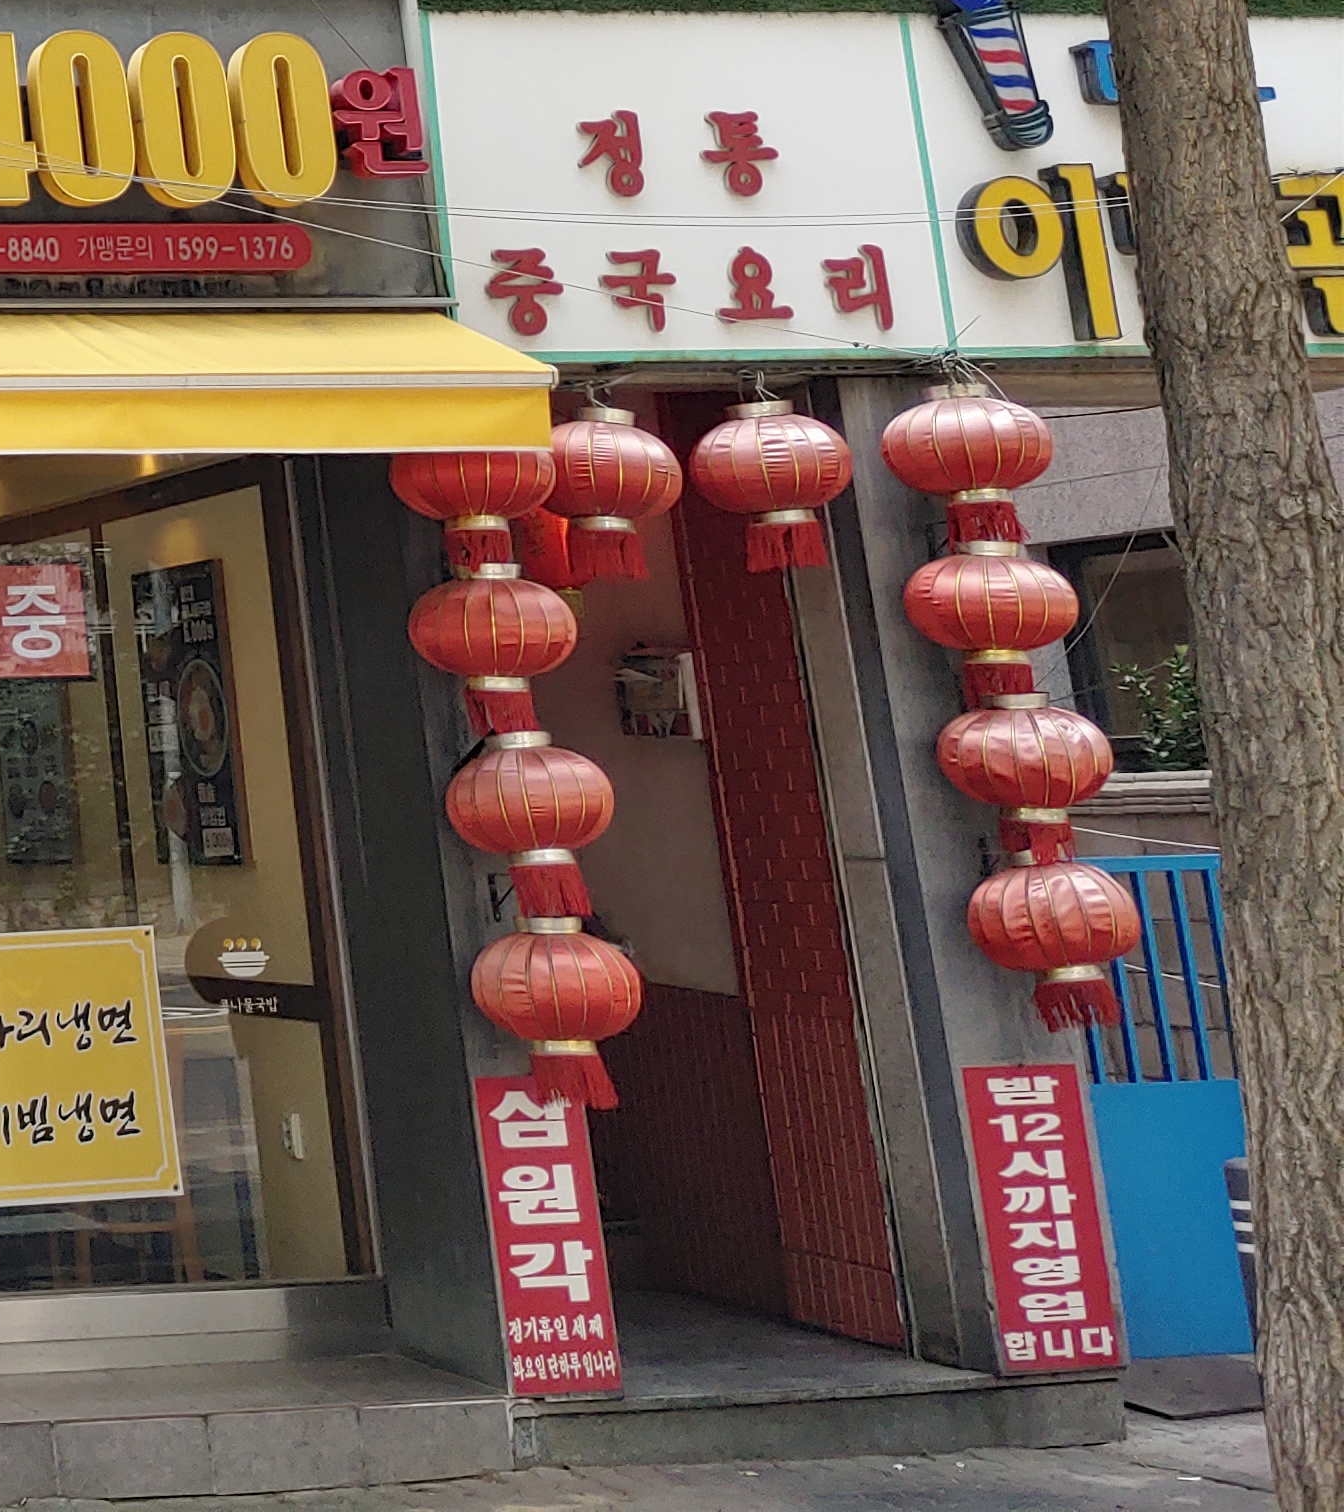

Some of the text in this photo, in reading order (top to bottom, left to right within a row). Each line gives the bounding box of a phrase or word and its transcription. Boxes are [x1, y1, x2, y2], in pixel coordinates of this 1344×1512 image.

[76, 234, 154, 262] 가맹문의
[164, 235, 295, 262] 1599-1376
[485, 243, 896, 337] 중국요리
[488, 1089, 594, 1303] 삼원각
[508, 1314, 570, 1344] 정기휴일
[512, 1354, 548, 1382] 화요일
